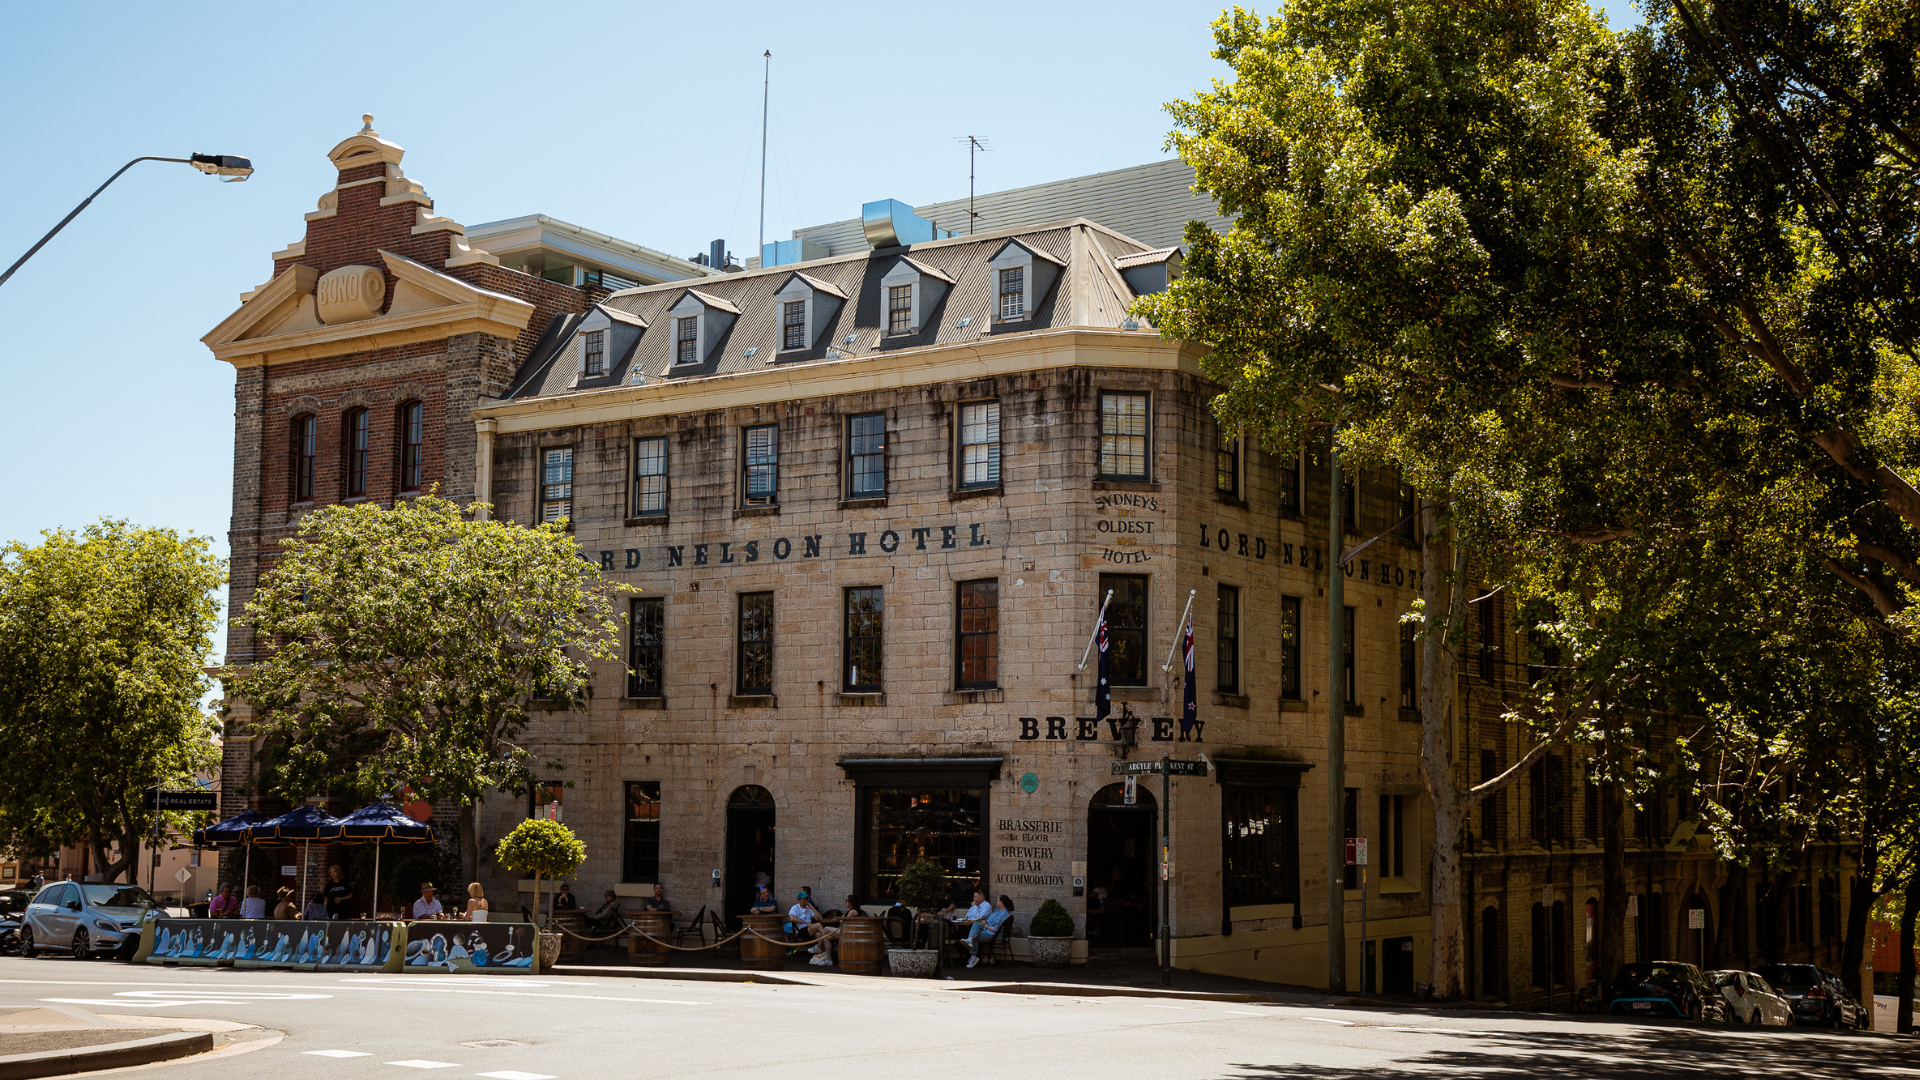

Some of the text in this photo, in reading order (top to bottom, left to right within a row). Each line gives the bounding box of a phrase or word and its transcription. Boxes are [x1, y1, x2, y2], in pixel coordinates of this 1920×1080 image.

[320, 273, 359, 306] BOND
[1095, 493, 1158, 511] SYDNEY'S
[1118, 510, 1135, 518] EST
[1098, 520, 1154, 533] OLDEST
[576, 523, 990, 573] RD NELSON HOTEL.
[1102, 548, 1151, 564] HOTEL
[1200, 524, 1424, 591] LORD NELON HOT
[1170, 762, 1184, 770] KENT
[152, 797, 169, 805] ARE
[999, 819, 1063, 832] BRASSERIE
[1022, 834, 1049, 842] FLOOR
[1001, 846, 1055, 859] BREWERY
[1018, 860, 1041, 871] BAR
[996, 874, 1064, 886] ACCOMMODATION
